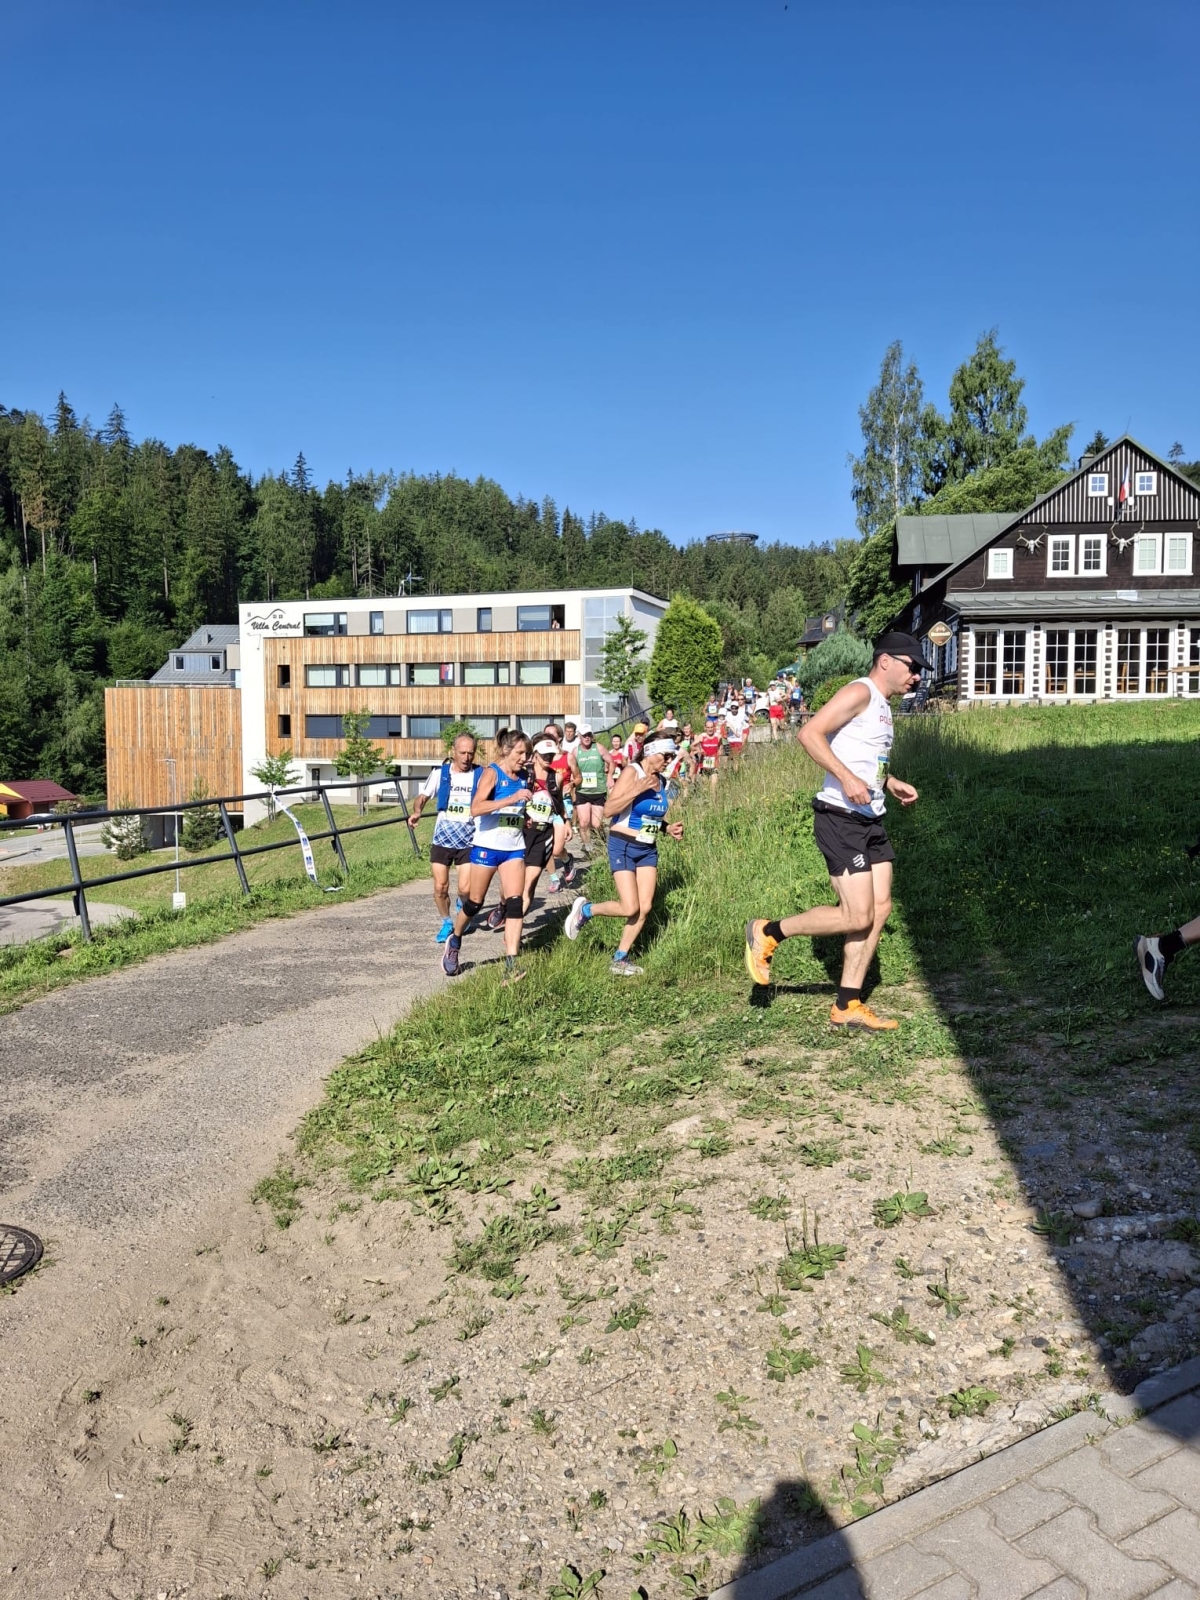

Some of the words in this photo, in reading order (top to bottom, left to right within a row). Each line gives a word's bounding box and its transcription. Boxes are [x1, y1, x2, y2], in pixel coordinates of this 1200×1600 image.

[251, 621, 269, 630] Villa
[272, 620, 301, 631] Central
[448, 805, 464, 813] 440
[506, 816, 520, 826] 161
